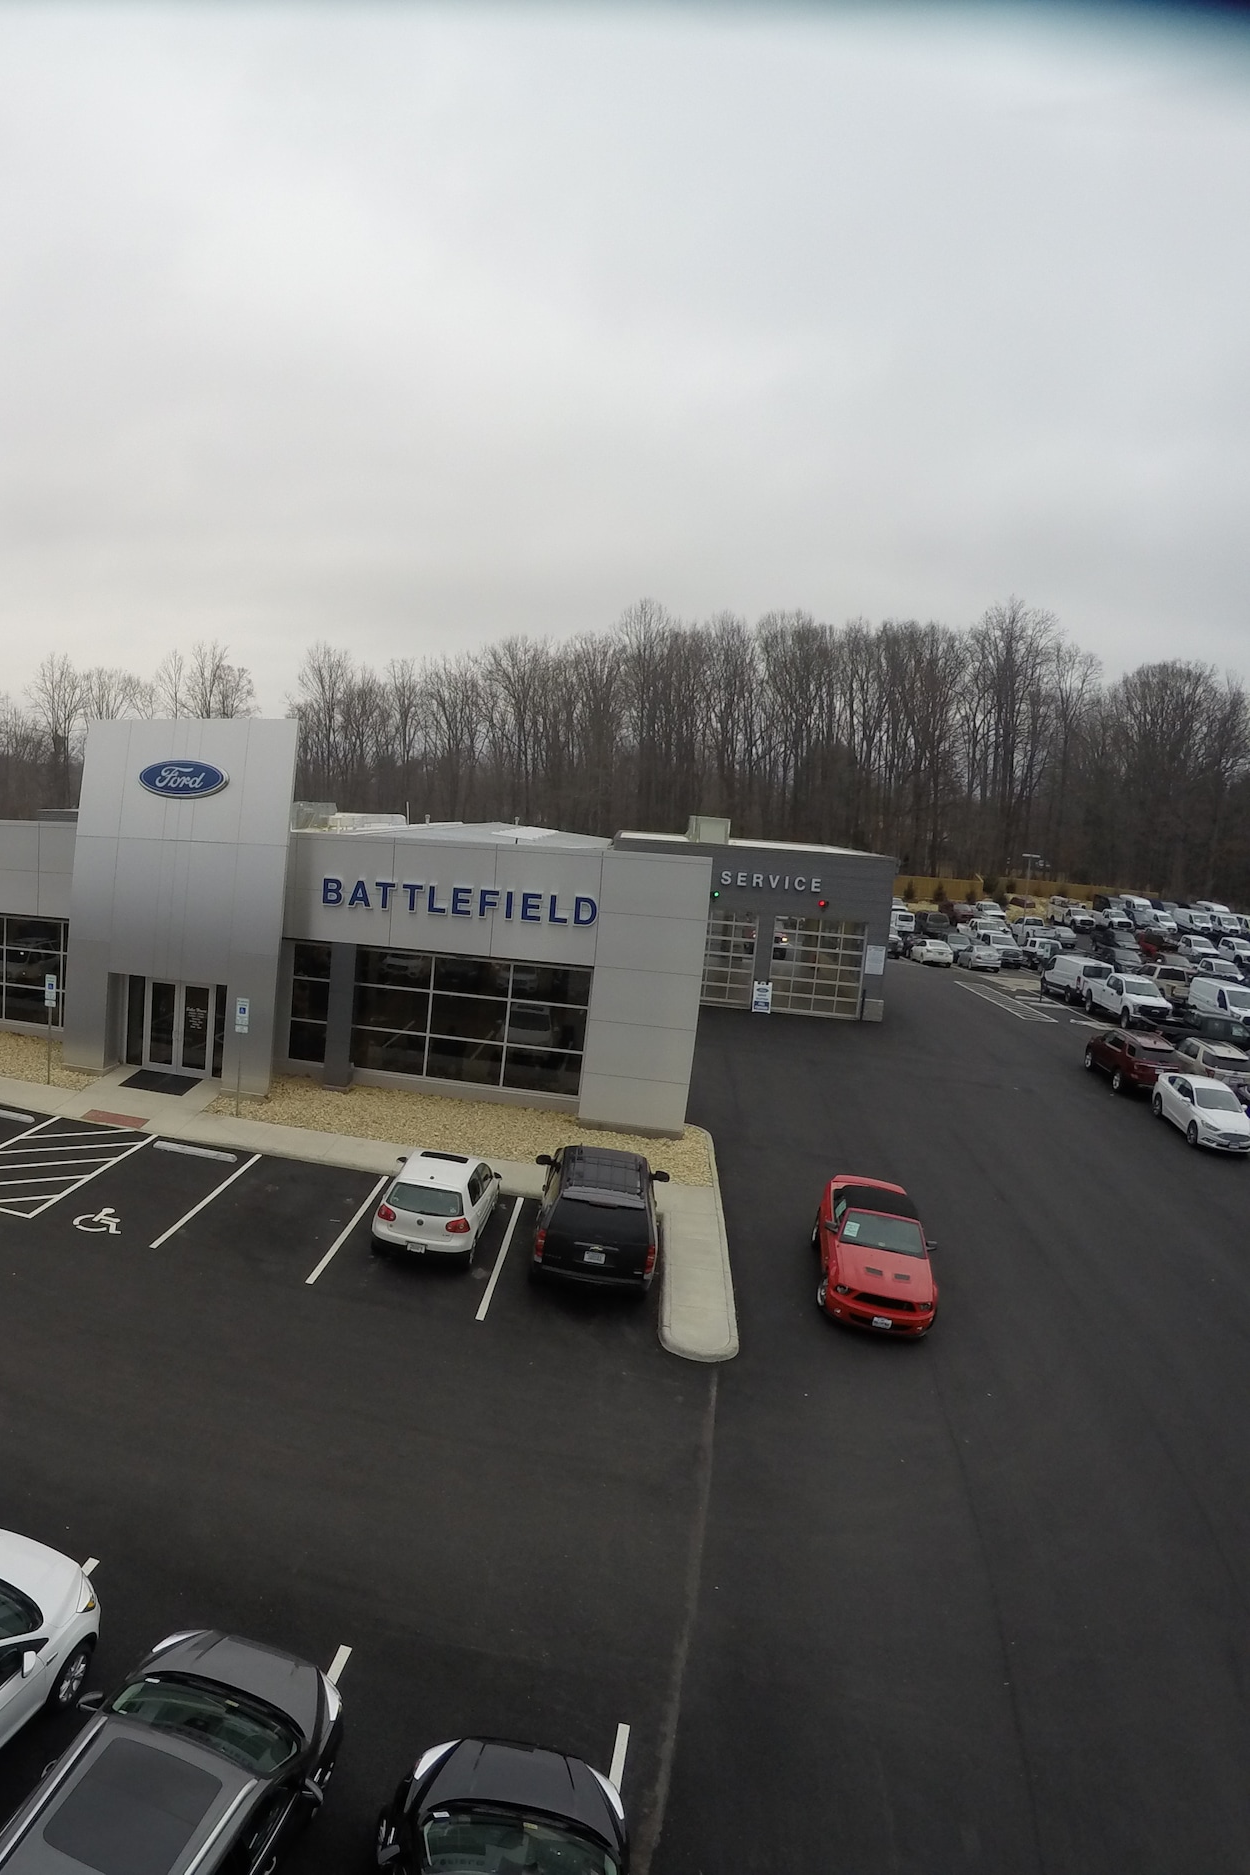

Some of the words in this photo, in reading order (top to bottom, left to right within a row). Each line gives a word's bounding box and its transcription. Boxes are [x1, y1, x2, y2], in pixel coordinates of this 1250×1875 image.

[155, 766, 206, 789] Ford
[720, 870, 823, 893] SERVICE
[320, 876, 600, 929] BATTLEFIELD
